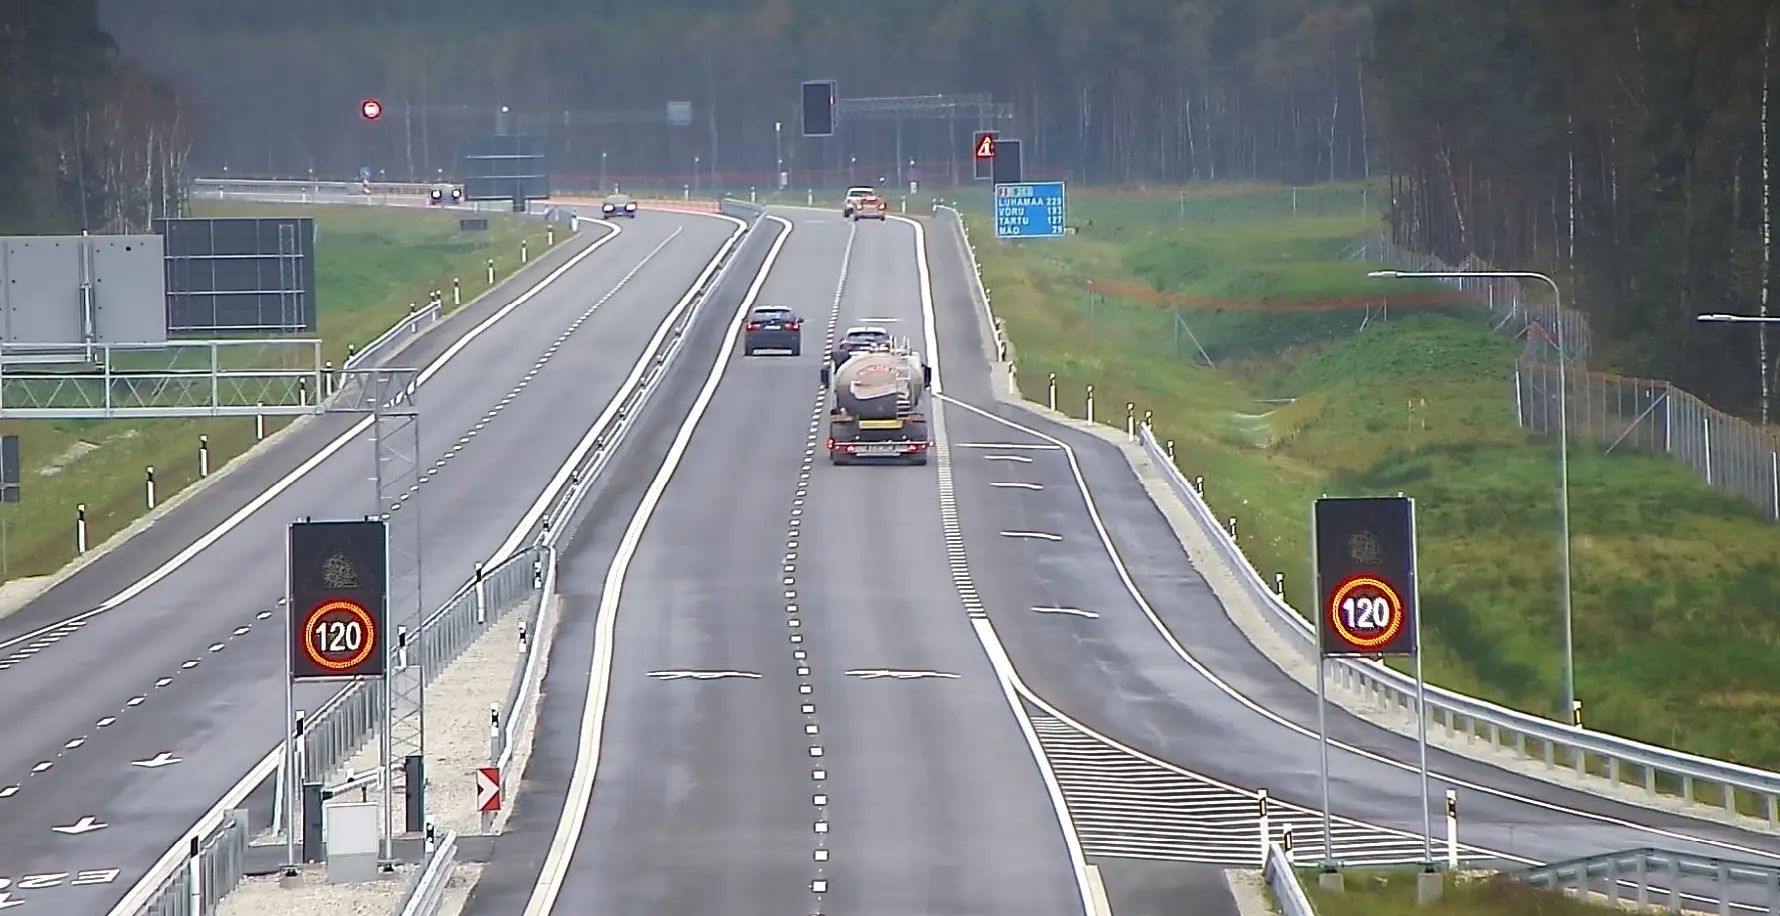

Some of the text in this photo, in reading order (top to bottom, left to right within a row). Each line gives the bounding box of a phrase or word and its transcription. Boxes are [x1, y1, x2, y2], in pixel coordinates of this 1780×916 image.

[999, 198, 1044, 206] LUHAMAA
[1047, 206, 1062, 215] 193
[999, 215, 1062, 225] TARTU 127
[1342, 596, 1390, 628] 120
[315, 621, 361, 651] 120
[0, 868, 120, 890] E2
